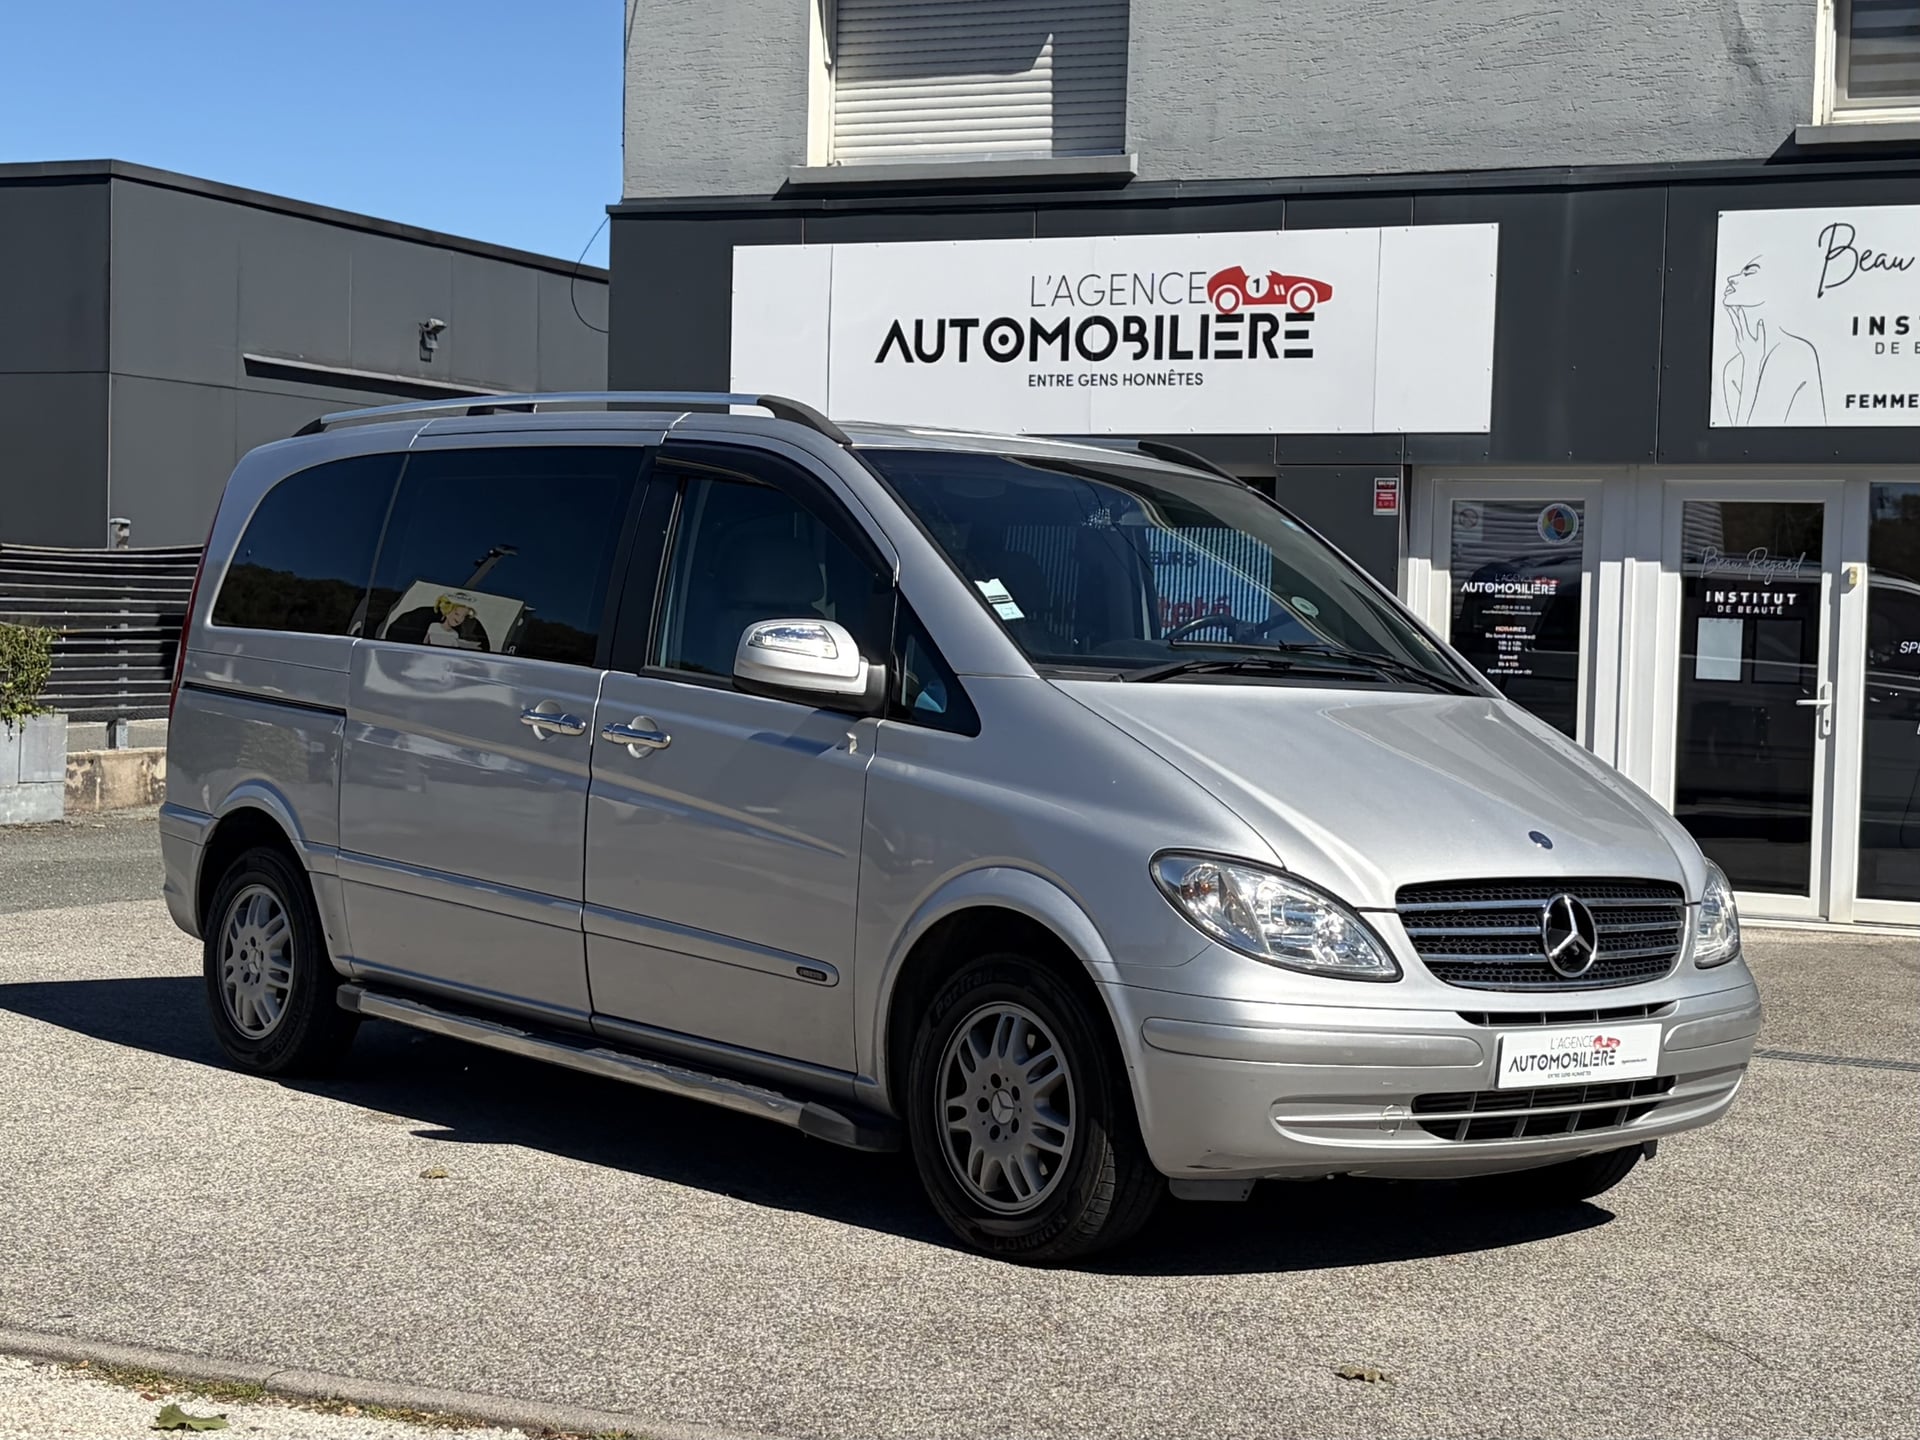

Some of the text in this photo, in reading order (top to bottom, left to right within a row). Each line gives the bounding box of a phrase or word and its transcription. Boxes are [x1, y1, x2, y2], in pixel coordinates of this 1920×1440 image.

[1818, 222, 1915, 299] Beau
[1030, 271, 1207, 307] L'AGENCE
[1852, 315, 1920, 336] INS
[1875, 342, 1900, 355] DE
[1028, 369, 1204, 387] ENTRE GENS HONNÊTES
[1700, 546, 1806, 585] Beau Regard
[1706, 591, 1797, 605] INSTITUT
[1717, 605, 1732, 613] DE
